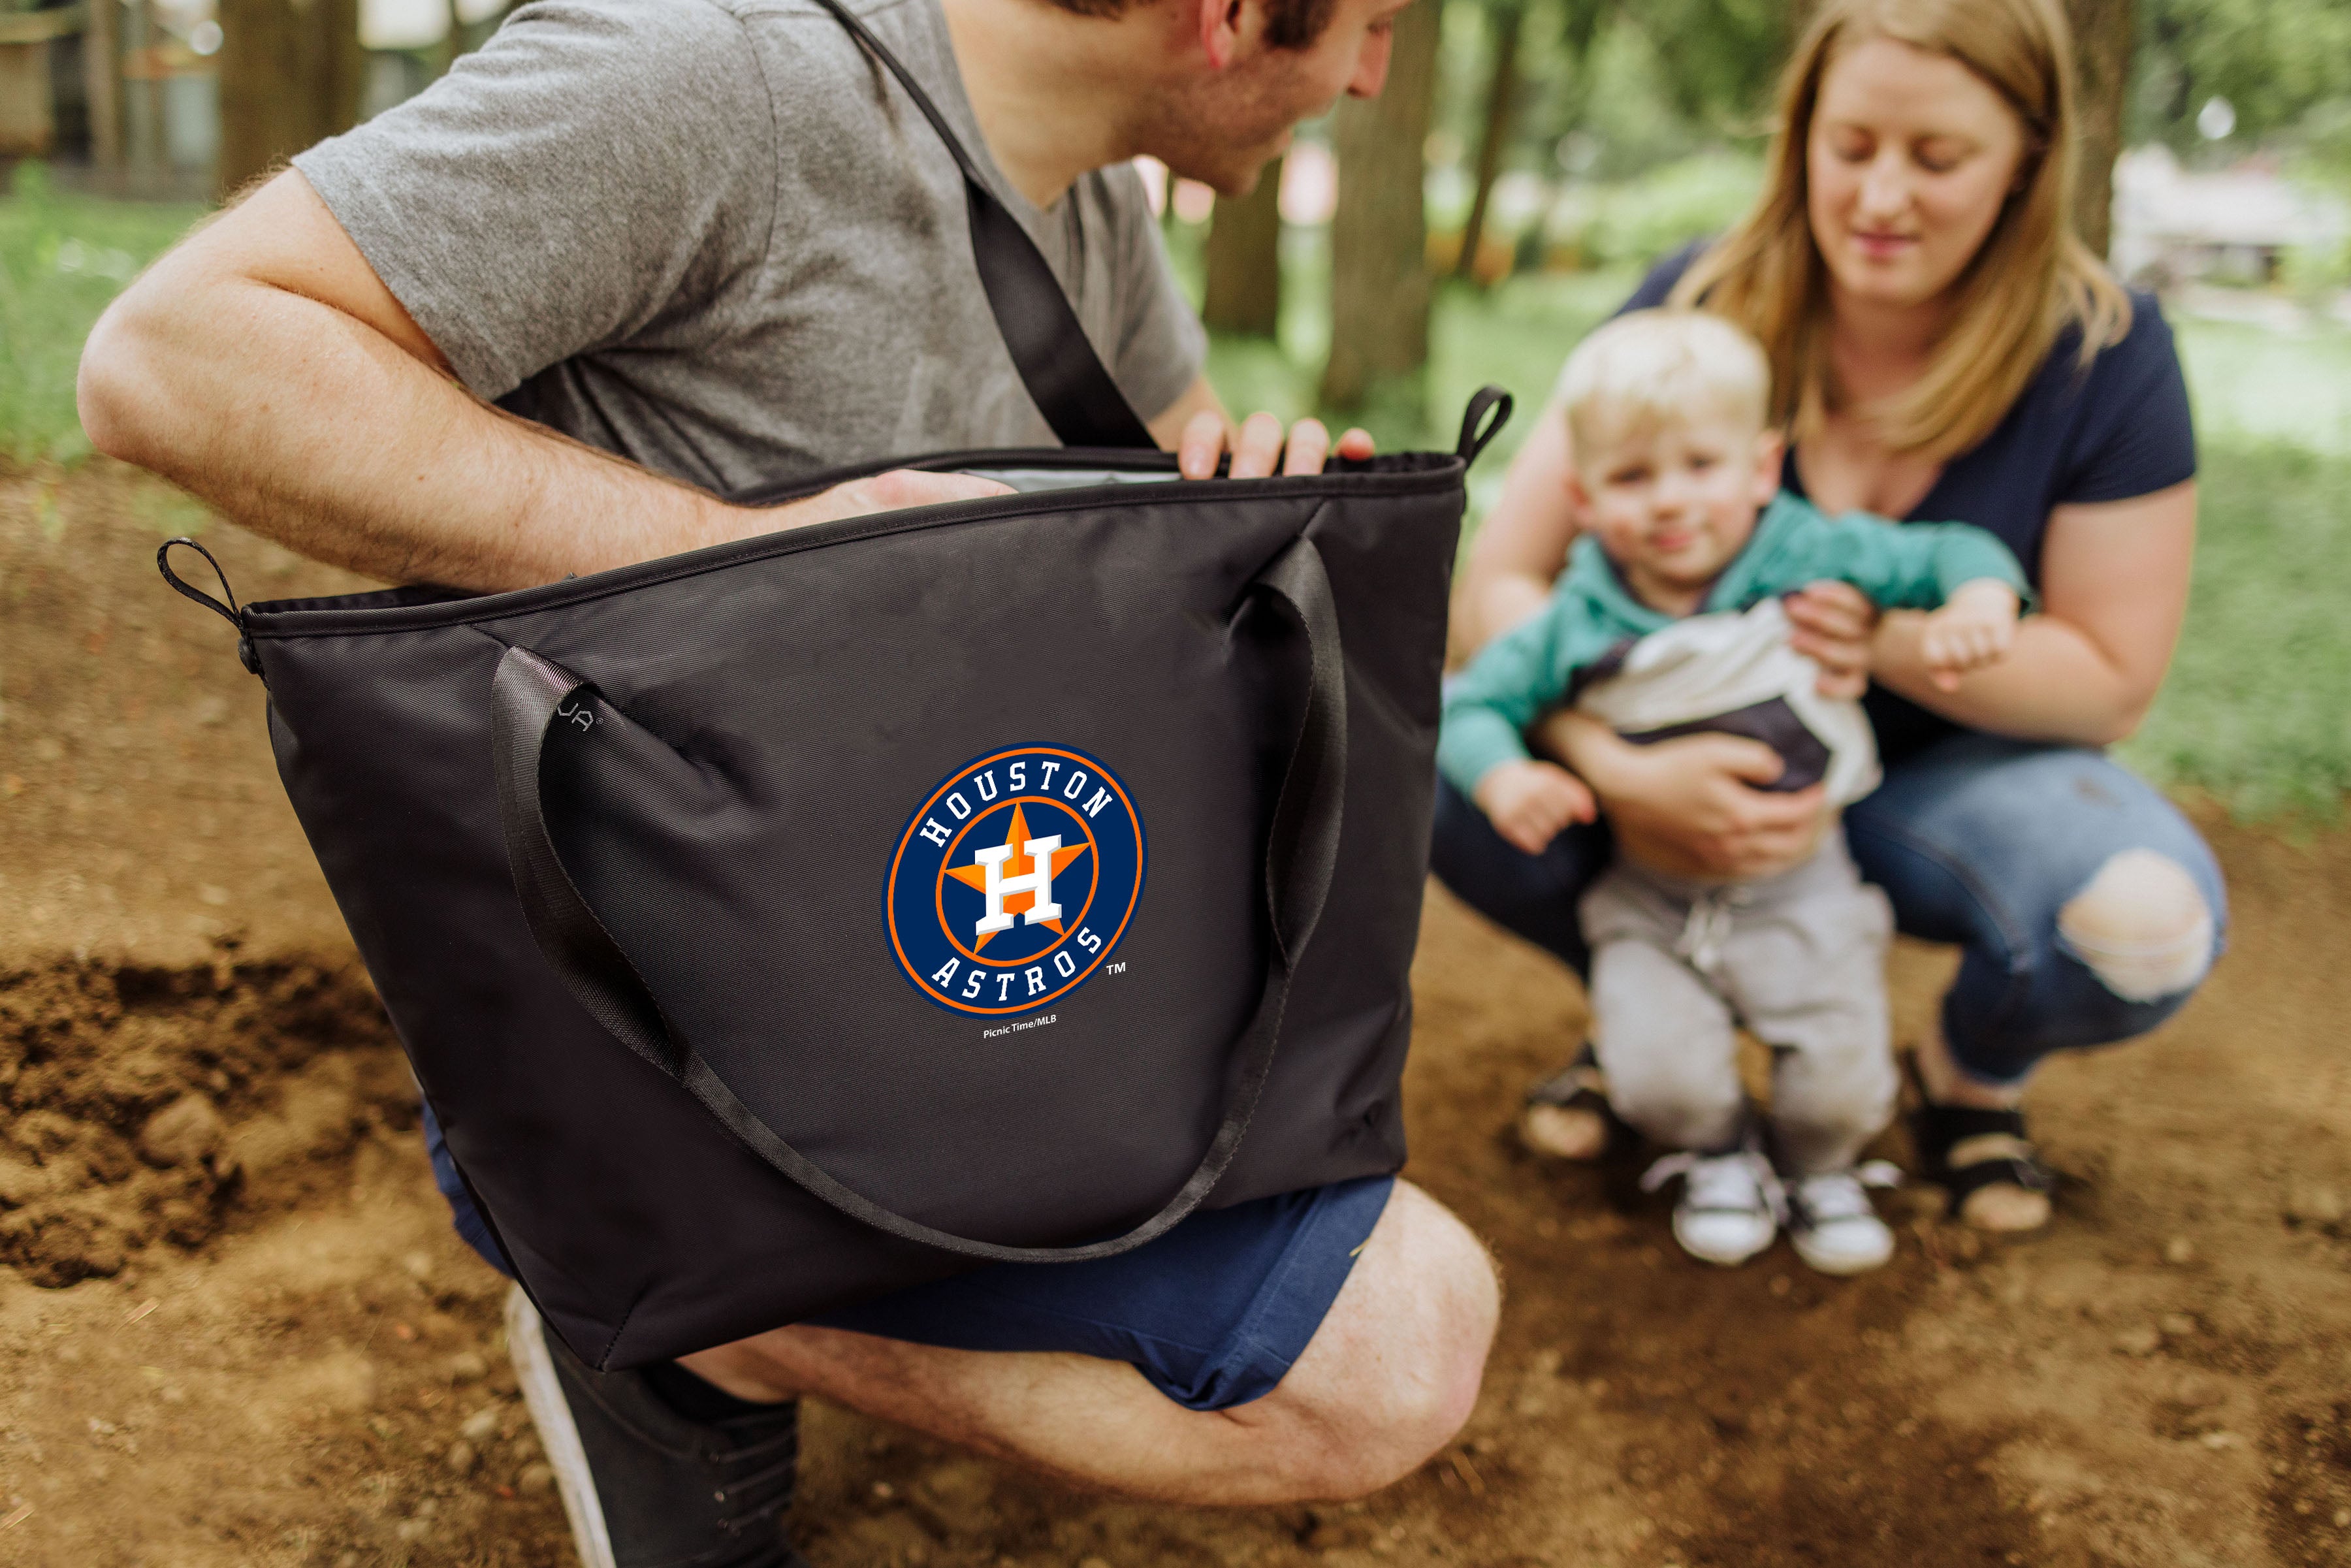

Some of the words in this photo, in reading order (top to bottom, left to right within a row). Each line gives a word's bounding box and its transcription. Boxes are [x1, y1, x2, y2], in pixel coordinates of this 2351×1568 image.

[919, 761, 1113, 848] HOUSTON
[974, 834, 1062, 936] H
[931, 927, 1102, 1002] ASTROS
[1106, 961, 1127, 976] TM
[984, 1026, 1010, 1039] Picnic
[1011, 1014, 1057, 1032] Time/MLB
